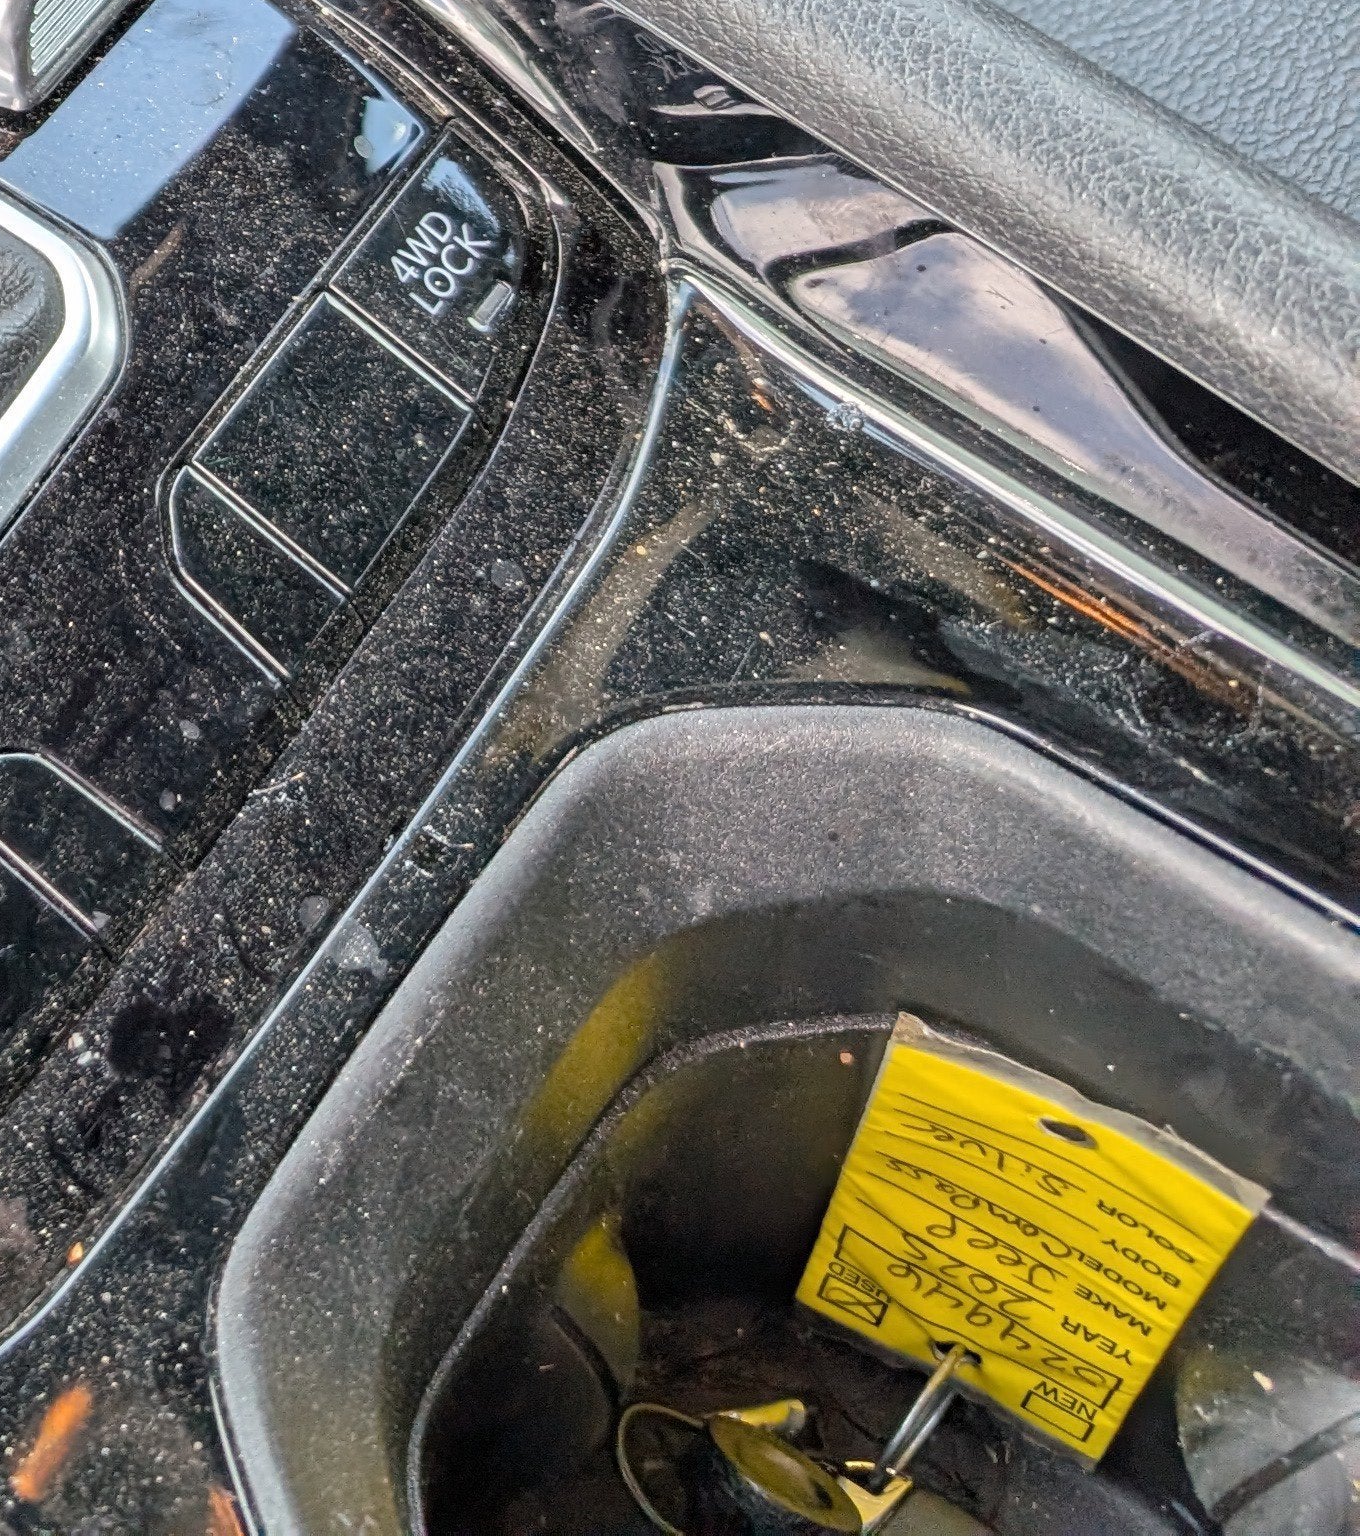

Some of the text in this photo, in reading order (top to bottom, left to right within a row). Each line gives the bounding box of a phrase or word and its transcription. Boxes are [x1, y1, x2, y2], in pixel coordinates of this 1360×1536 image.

[391, 211, 452, 283] 4WD
[408, 222, 492, 315] LOCK
[1096, 1199, 1195, 1263] COLOR
[829, 1261, 891, 1304] USED
[1071, 1247, 1167, 1310] MODEL
[1101, 1239, 1180, 1288] BODY
[1074, 1283, 1152, 1336] MAKE
[1061, 1316, 1131, 1365] YEAR
[1035, 1381, 1097, 1421] NEW
